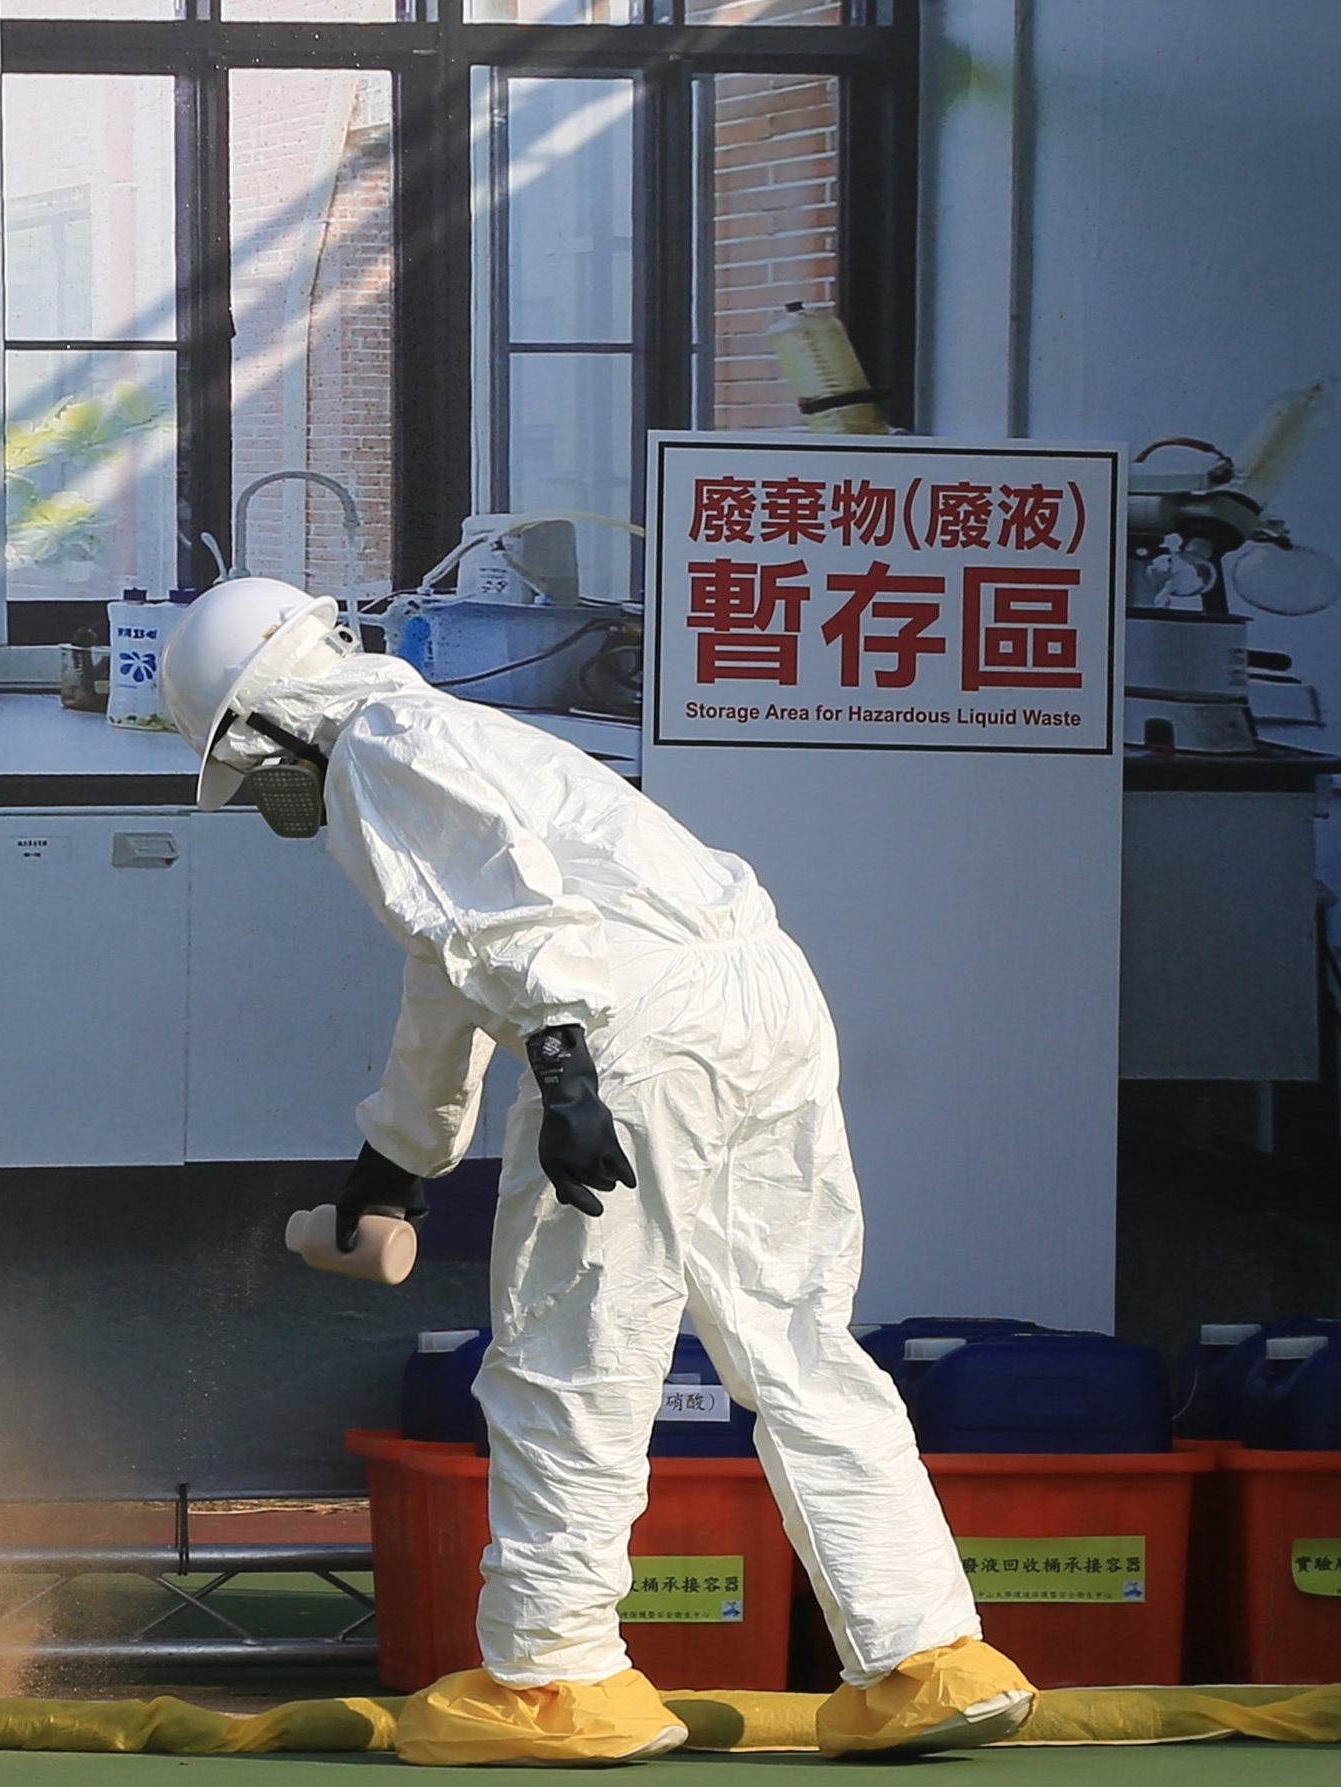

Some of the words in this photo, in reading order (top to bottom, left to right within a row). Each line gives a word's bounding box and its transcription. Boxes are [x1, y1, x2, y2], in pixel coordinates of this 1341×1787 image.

[688, 476, 1086, 554] 廢棄物(廢液)
[686, 557, 1083, 691] 暫存區
[685, 702, 760, 724] Storage
[765, 704, 809, 721] Area
[815, 705, 843, 722] for
[848, 706, 951, 724] Hazardous
[957, 708, 1017, 728] Liquid
[1023, 709, 1081, 727] Waste
[659, 1392, 715, 1412] 硝酸)
